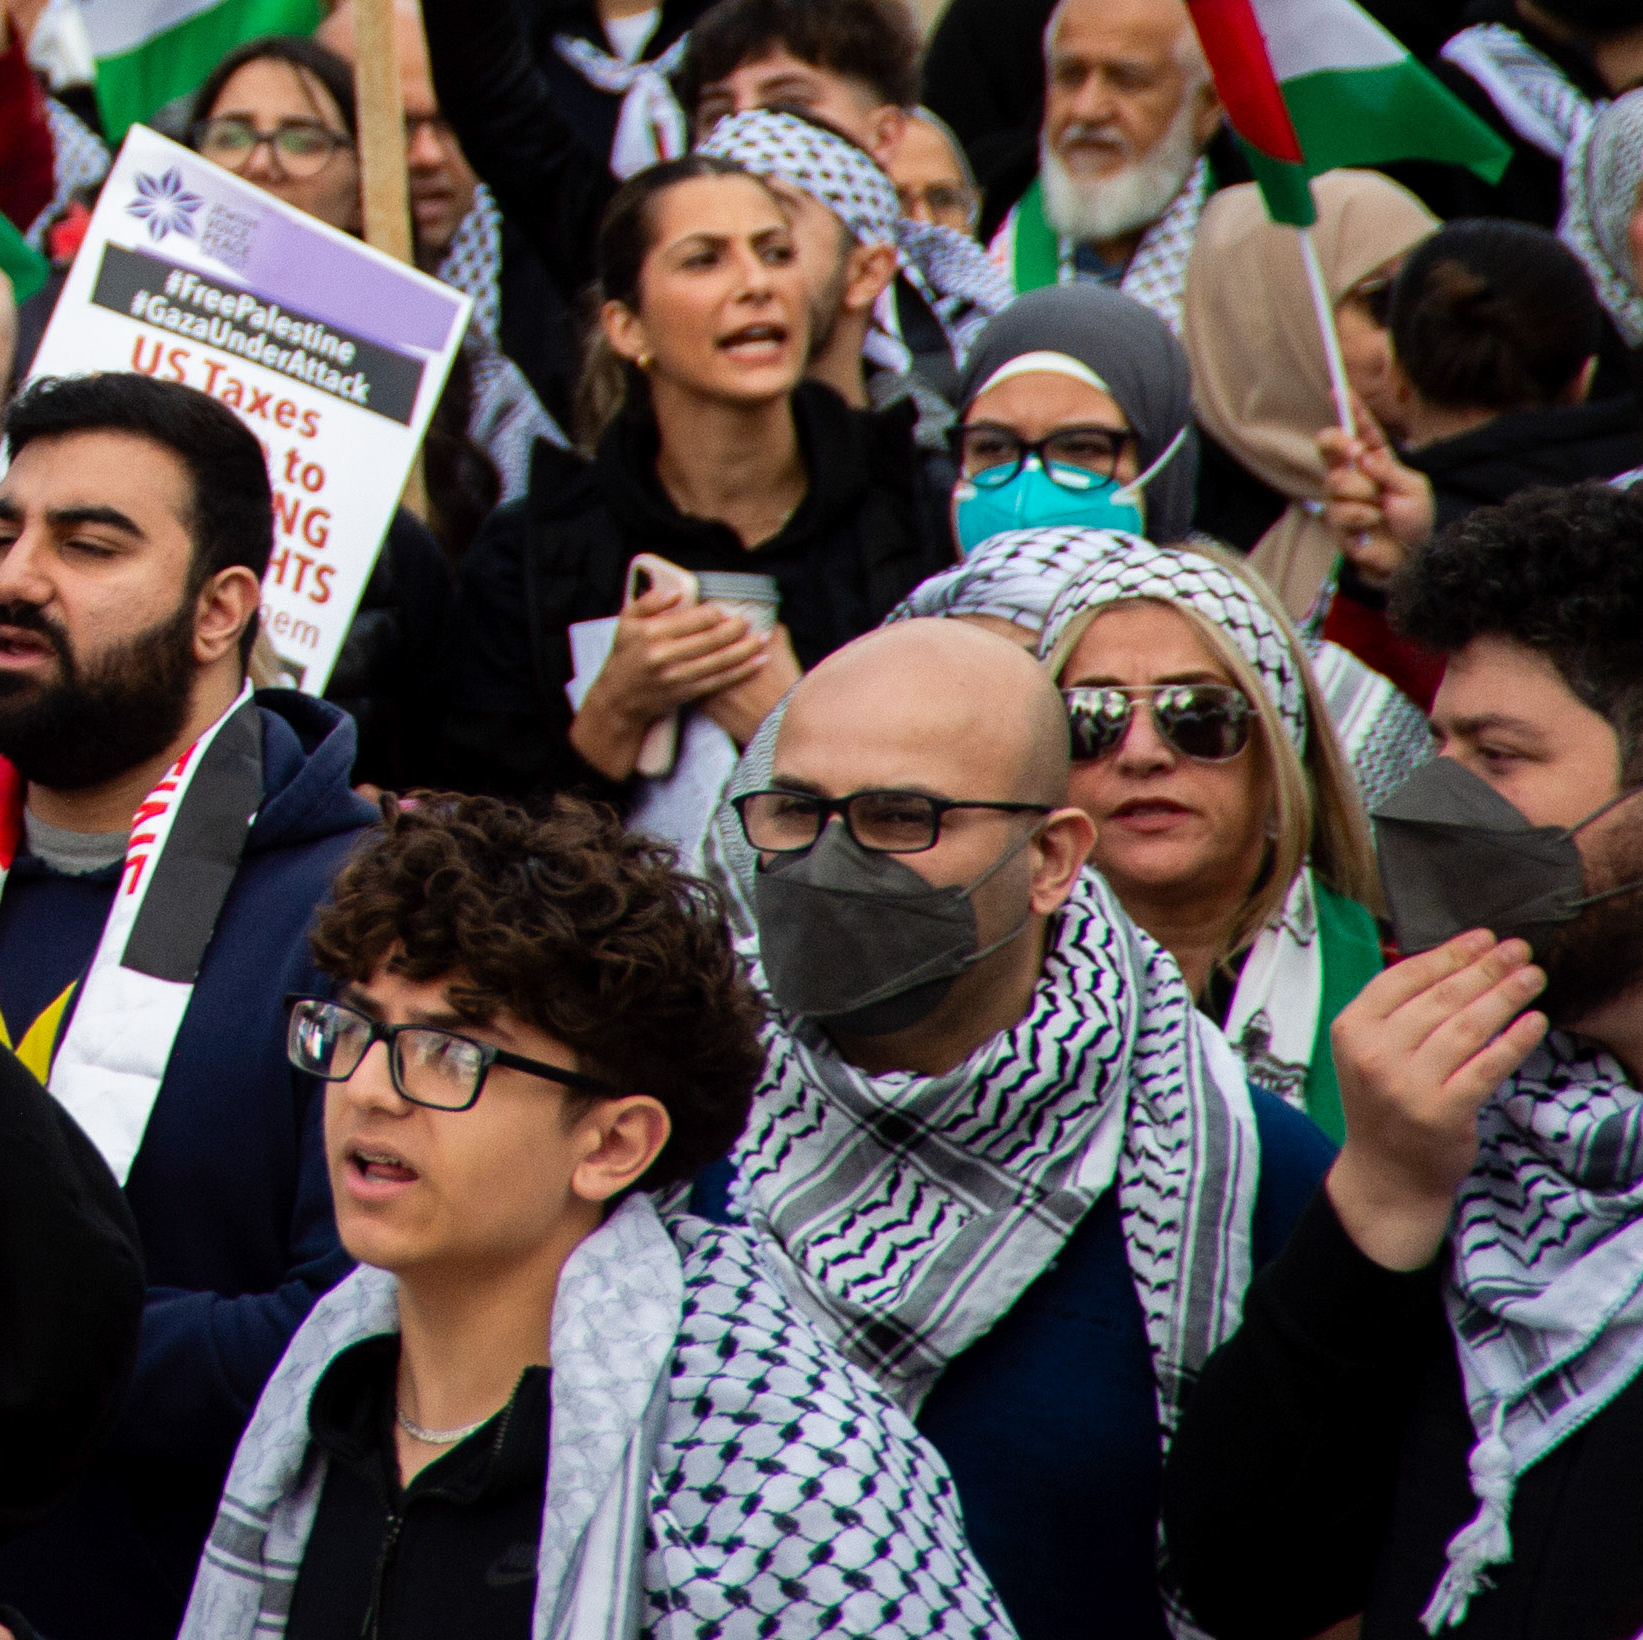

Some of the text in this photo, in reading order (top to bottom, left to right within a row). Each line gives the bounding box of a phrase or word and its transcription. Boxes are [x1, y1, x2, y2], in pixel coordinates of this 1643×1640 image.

[130, 289, 370, 405] #GazaUnderAttack
[164, 269, 356, 366] #FreePalestine
[130, 333, 322, 439] US Taxes
[284, 448, 325, 493] to
